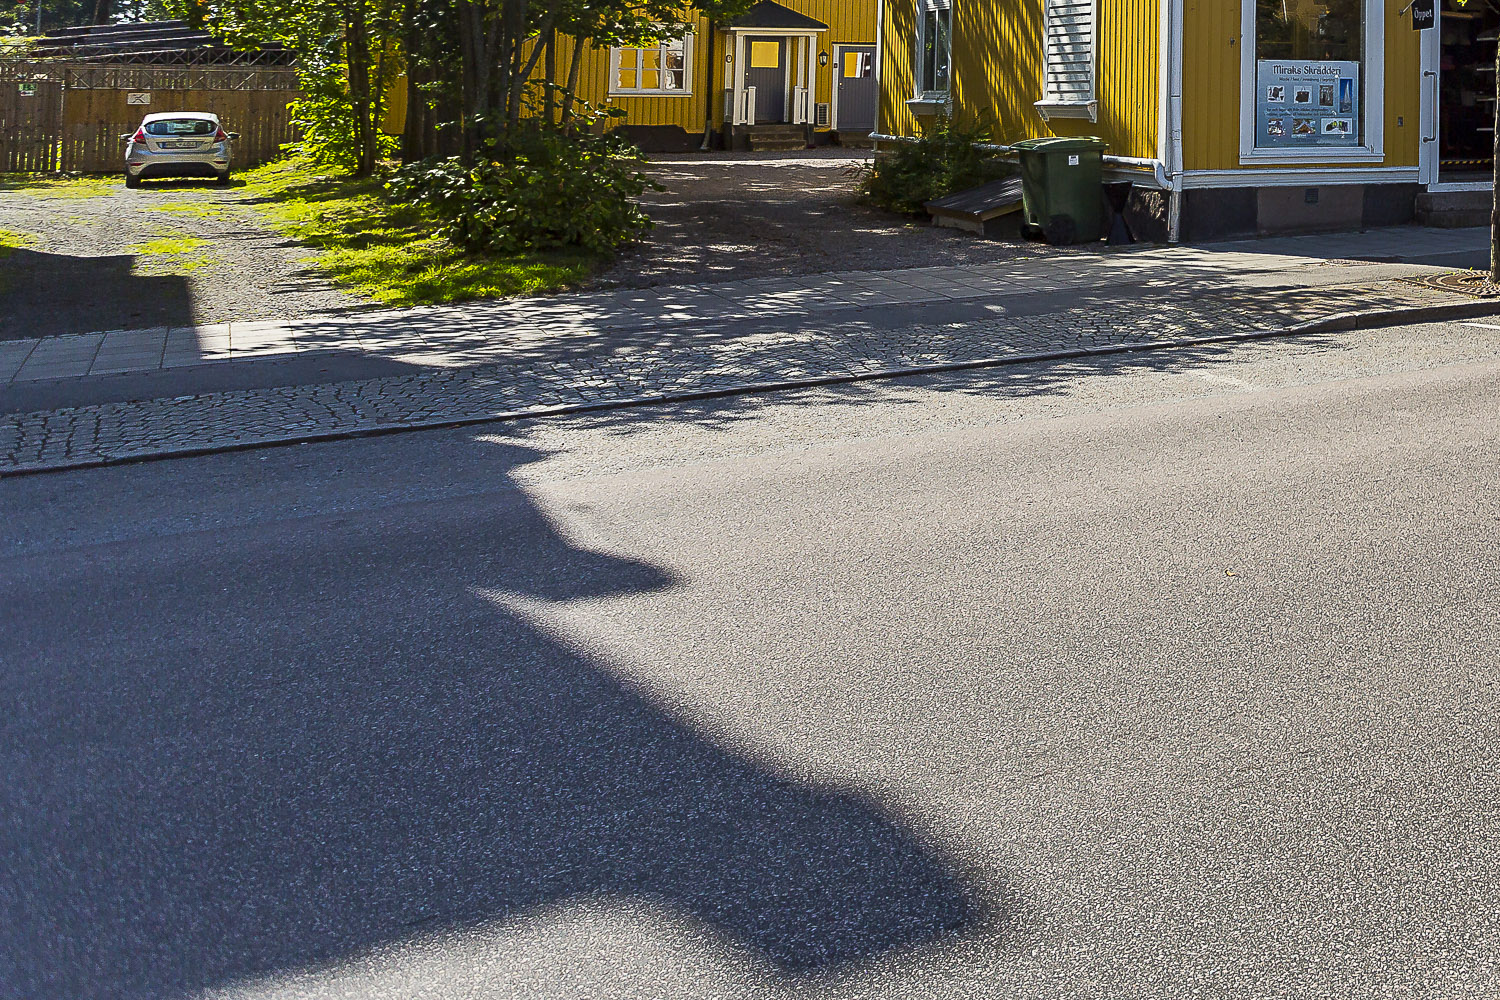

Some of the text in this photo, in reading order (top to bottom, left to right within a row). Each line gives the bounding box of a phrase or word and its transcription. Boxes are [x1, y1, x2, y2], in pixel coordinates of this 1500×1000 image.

[1413, 8, 1433, 20] Öppet
[1273, 64, 1341, 75] Miraks Skrädderi
